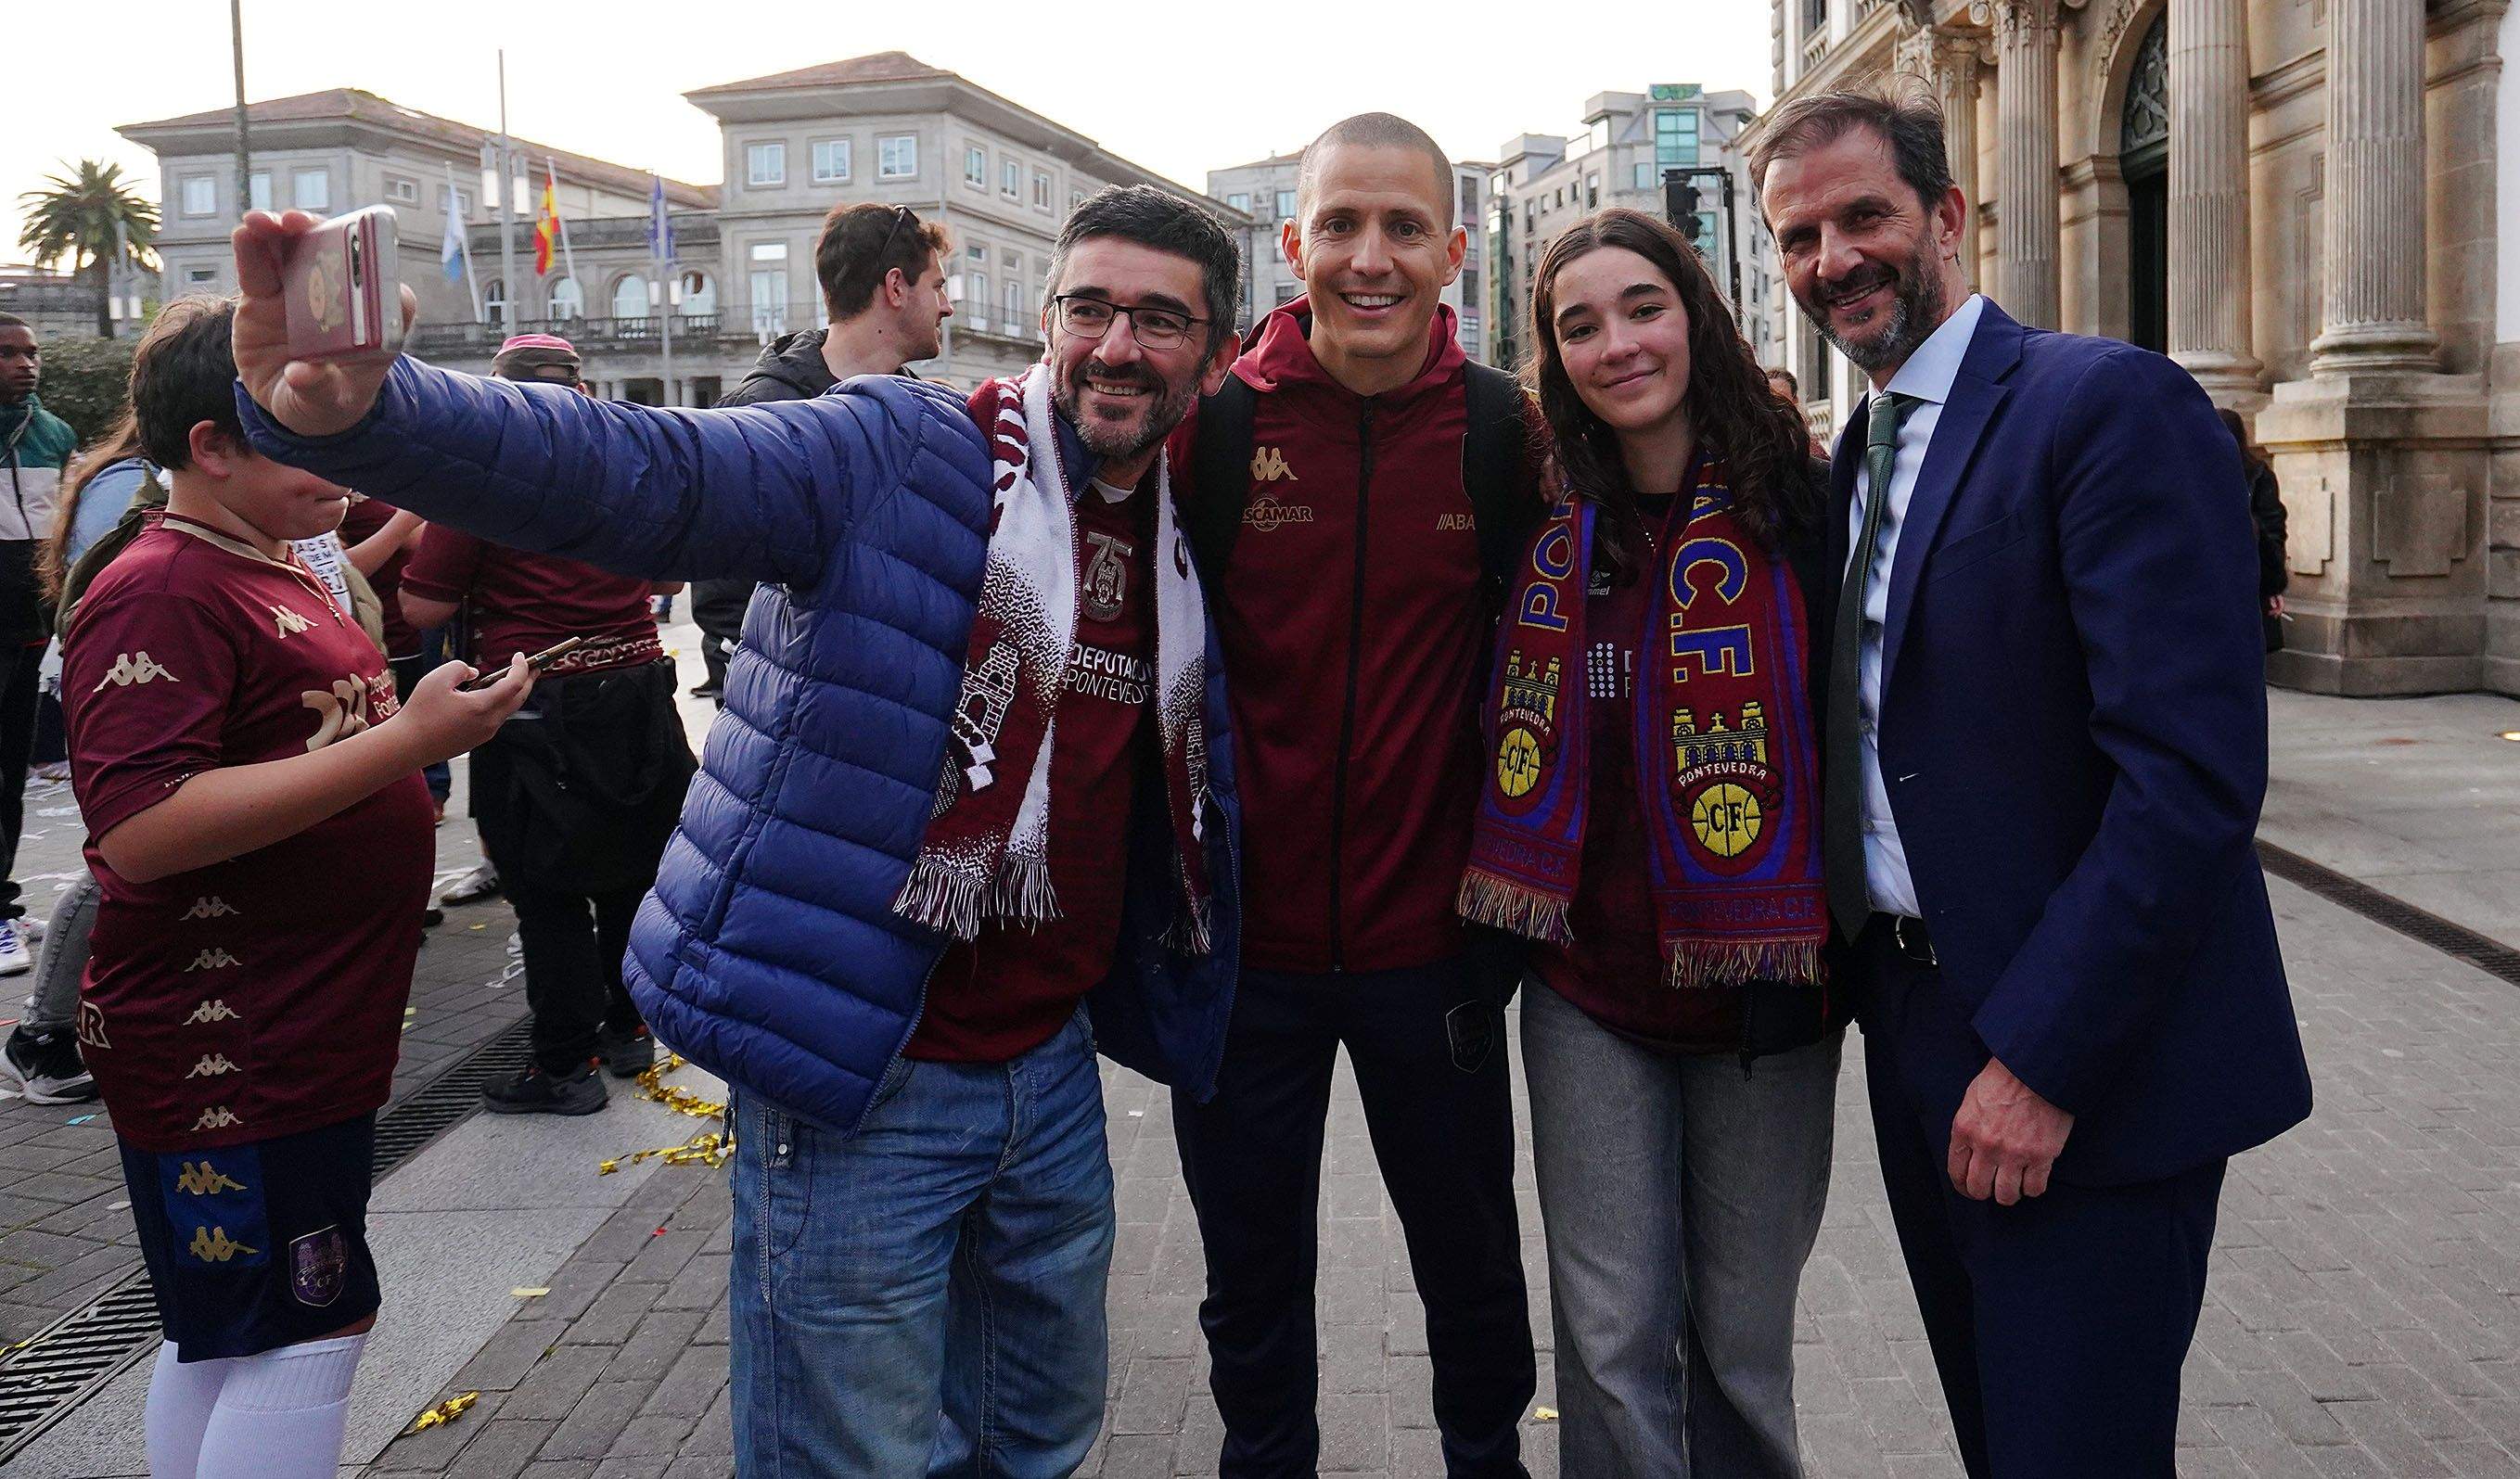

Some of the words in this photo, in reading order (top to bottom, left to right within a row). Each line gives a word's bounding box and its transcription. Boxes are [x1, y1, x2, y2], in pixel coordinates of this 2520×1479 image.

[1500, 708, 1551, 736] PONTEVEDRA
[1505, 745, 1530, 775] CF
[1678, 761, 1768, 787] PONTEVEDRA
[1709, 801, 1743, 833] CF
